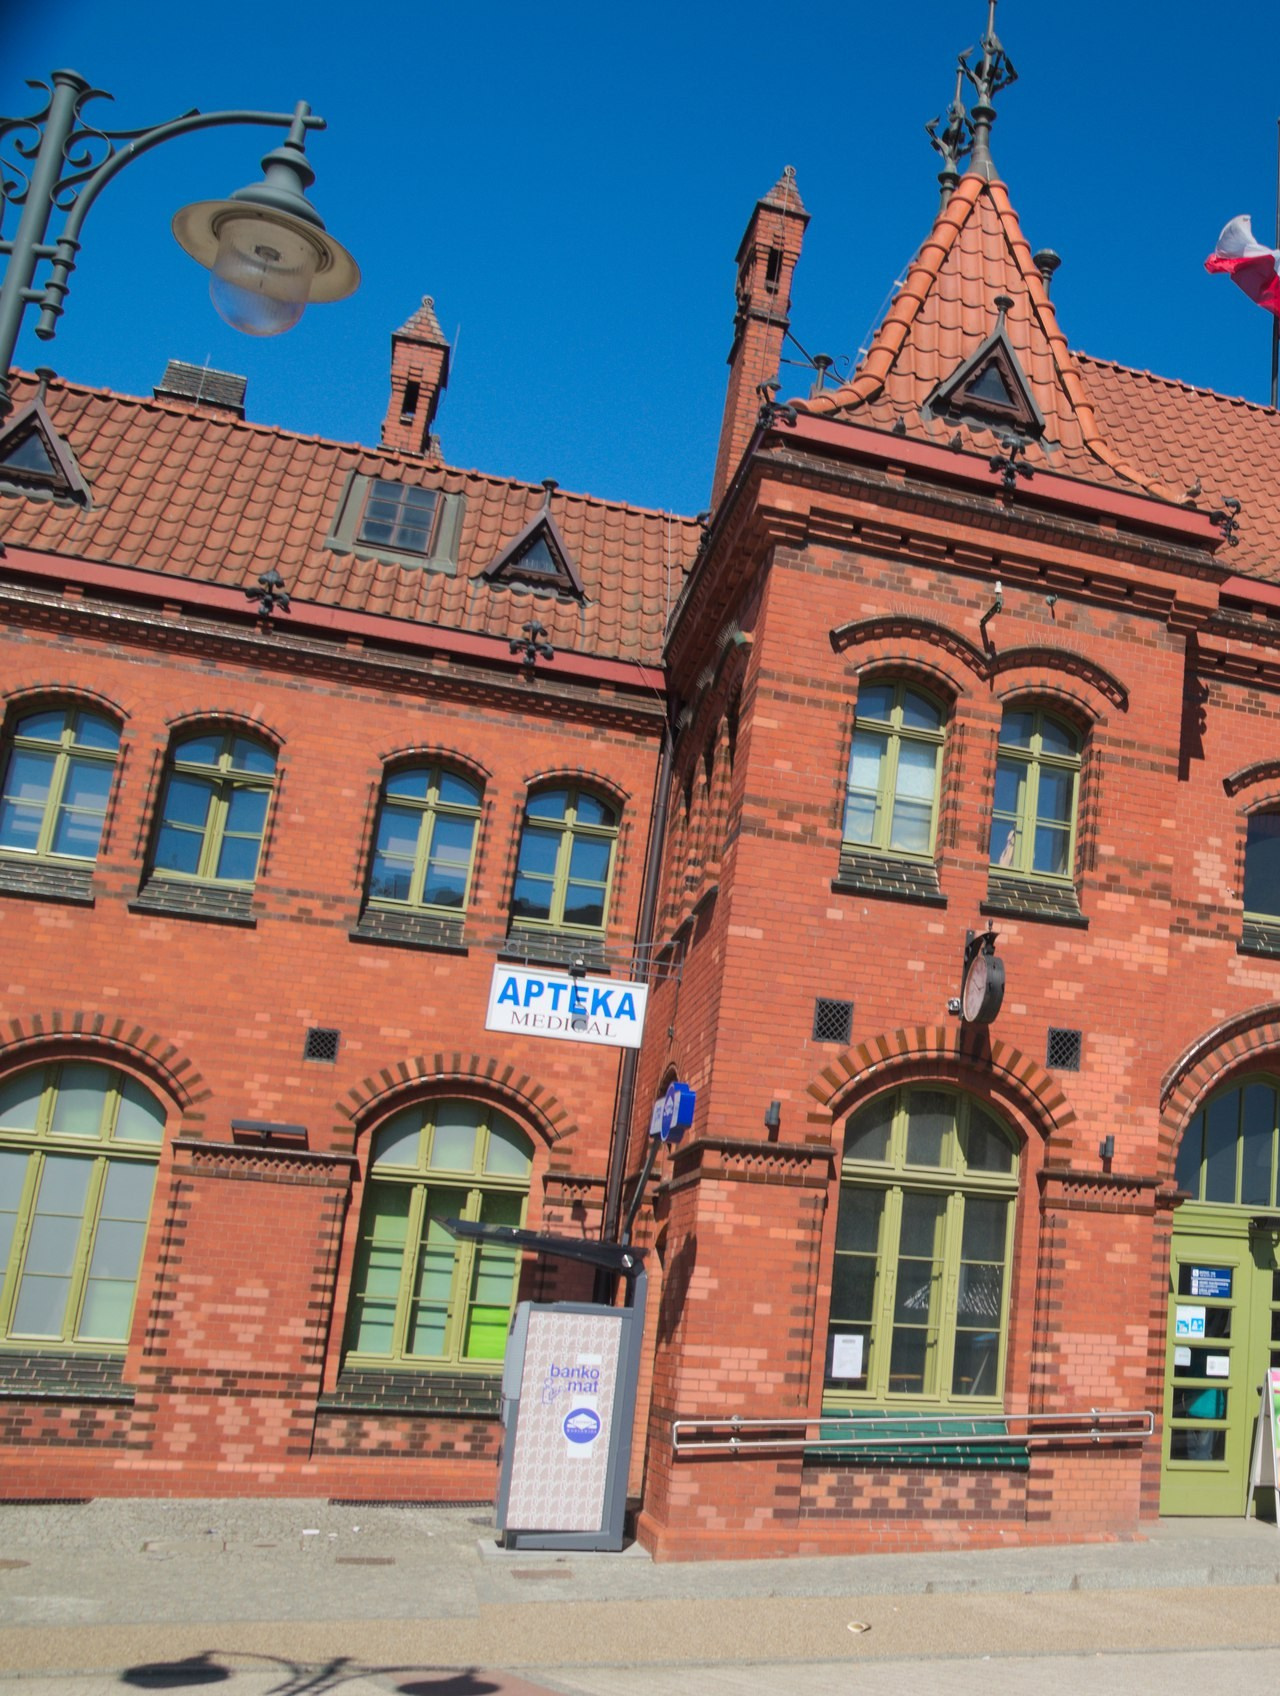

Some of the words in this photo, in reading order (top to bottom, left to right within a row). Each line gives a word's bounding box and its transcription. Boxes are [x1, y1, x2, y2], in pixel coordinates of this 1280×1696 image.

[497, 976, 637, 1021] APTEKA
[510, 1011, 617, 1038] MEDICAL
[550, 1363, 600, 1379] banko
[568, 1380, 599, 1393] mat
